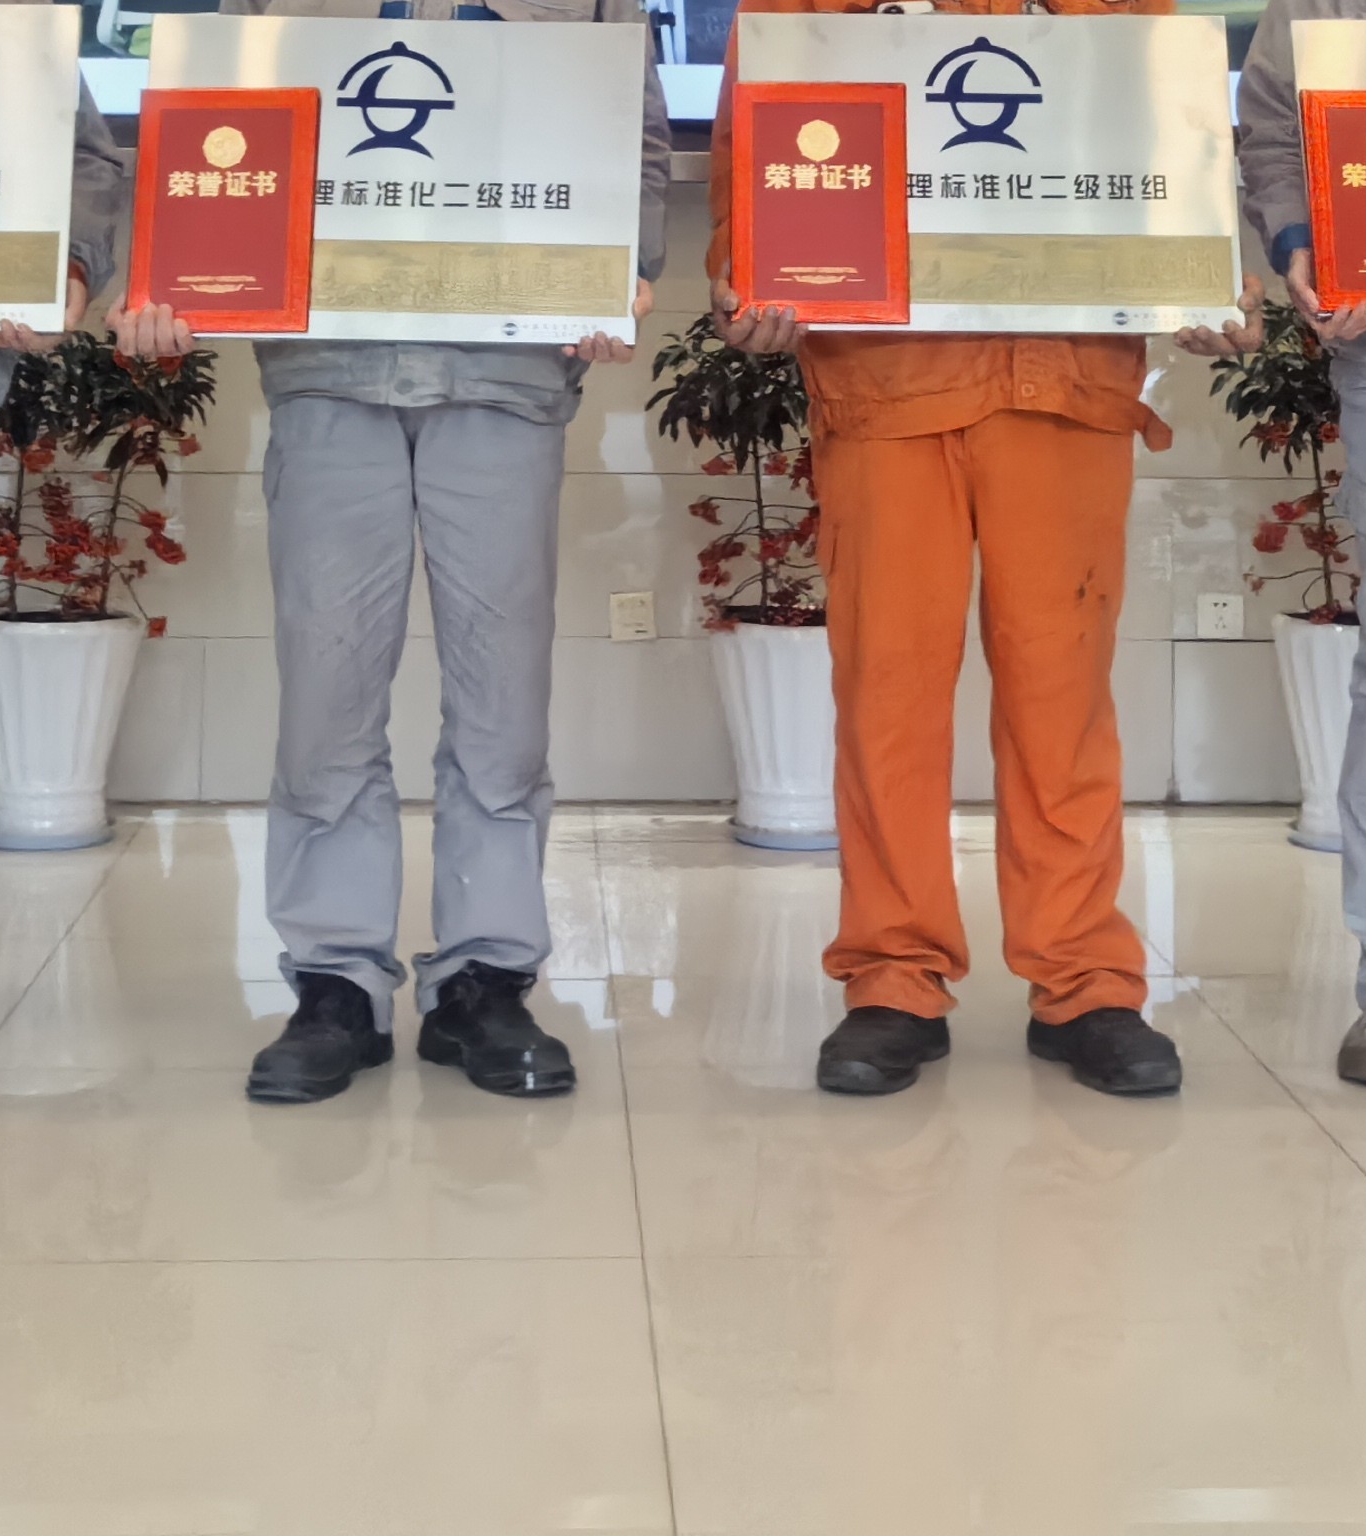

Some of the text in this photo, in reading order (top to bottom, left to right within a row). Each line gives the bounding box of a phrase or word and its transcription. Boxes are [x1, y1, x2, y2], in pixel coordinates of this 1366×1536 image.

[167, 170, 277, 198] 荣誉证书
[764, 164, 872, 191] 荣誉证书
[906, 173, 1168, 200] 理标准化二级班组
[314, 179, 571, 209] 理标准化二级班组
